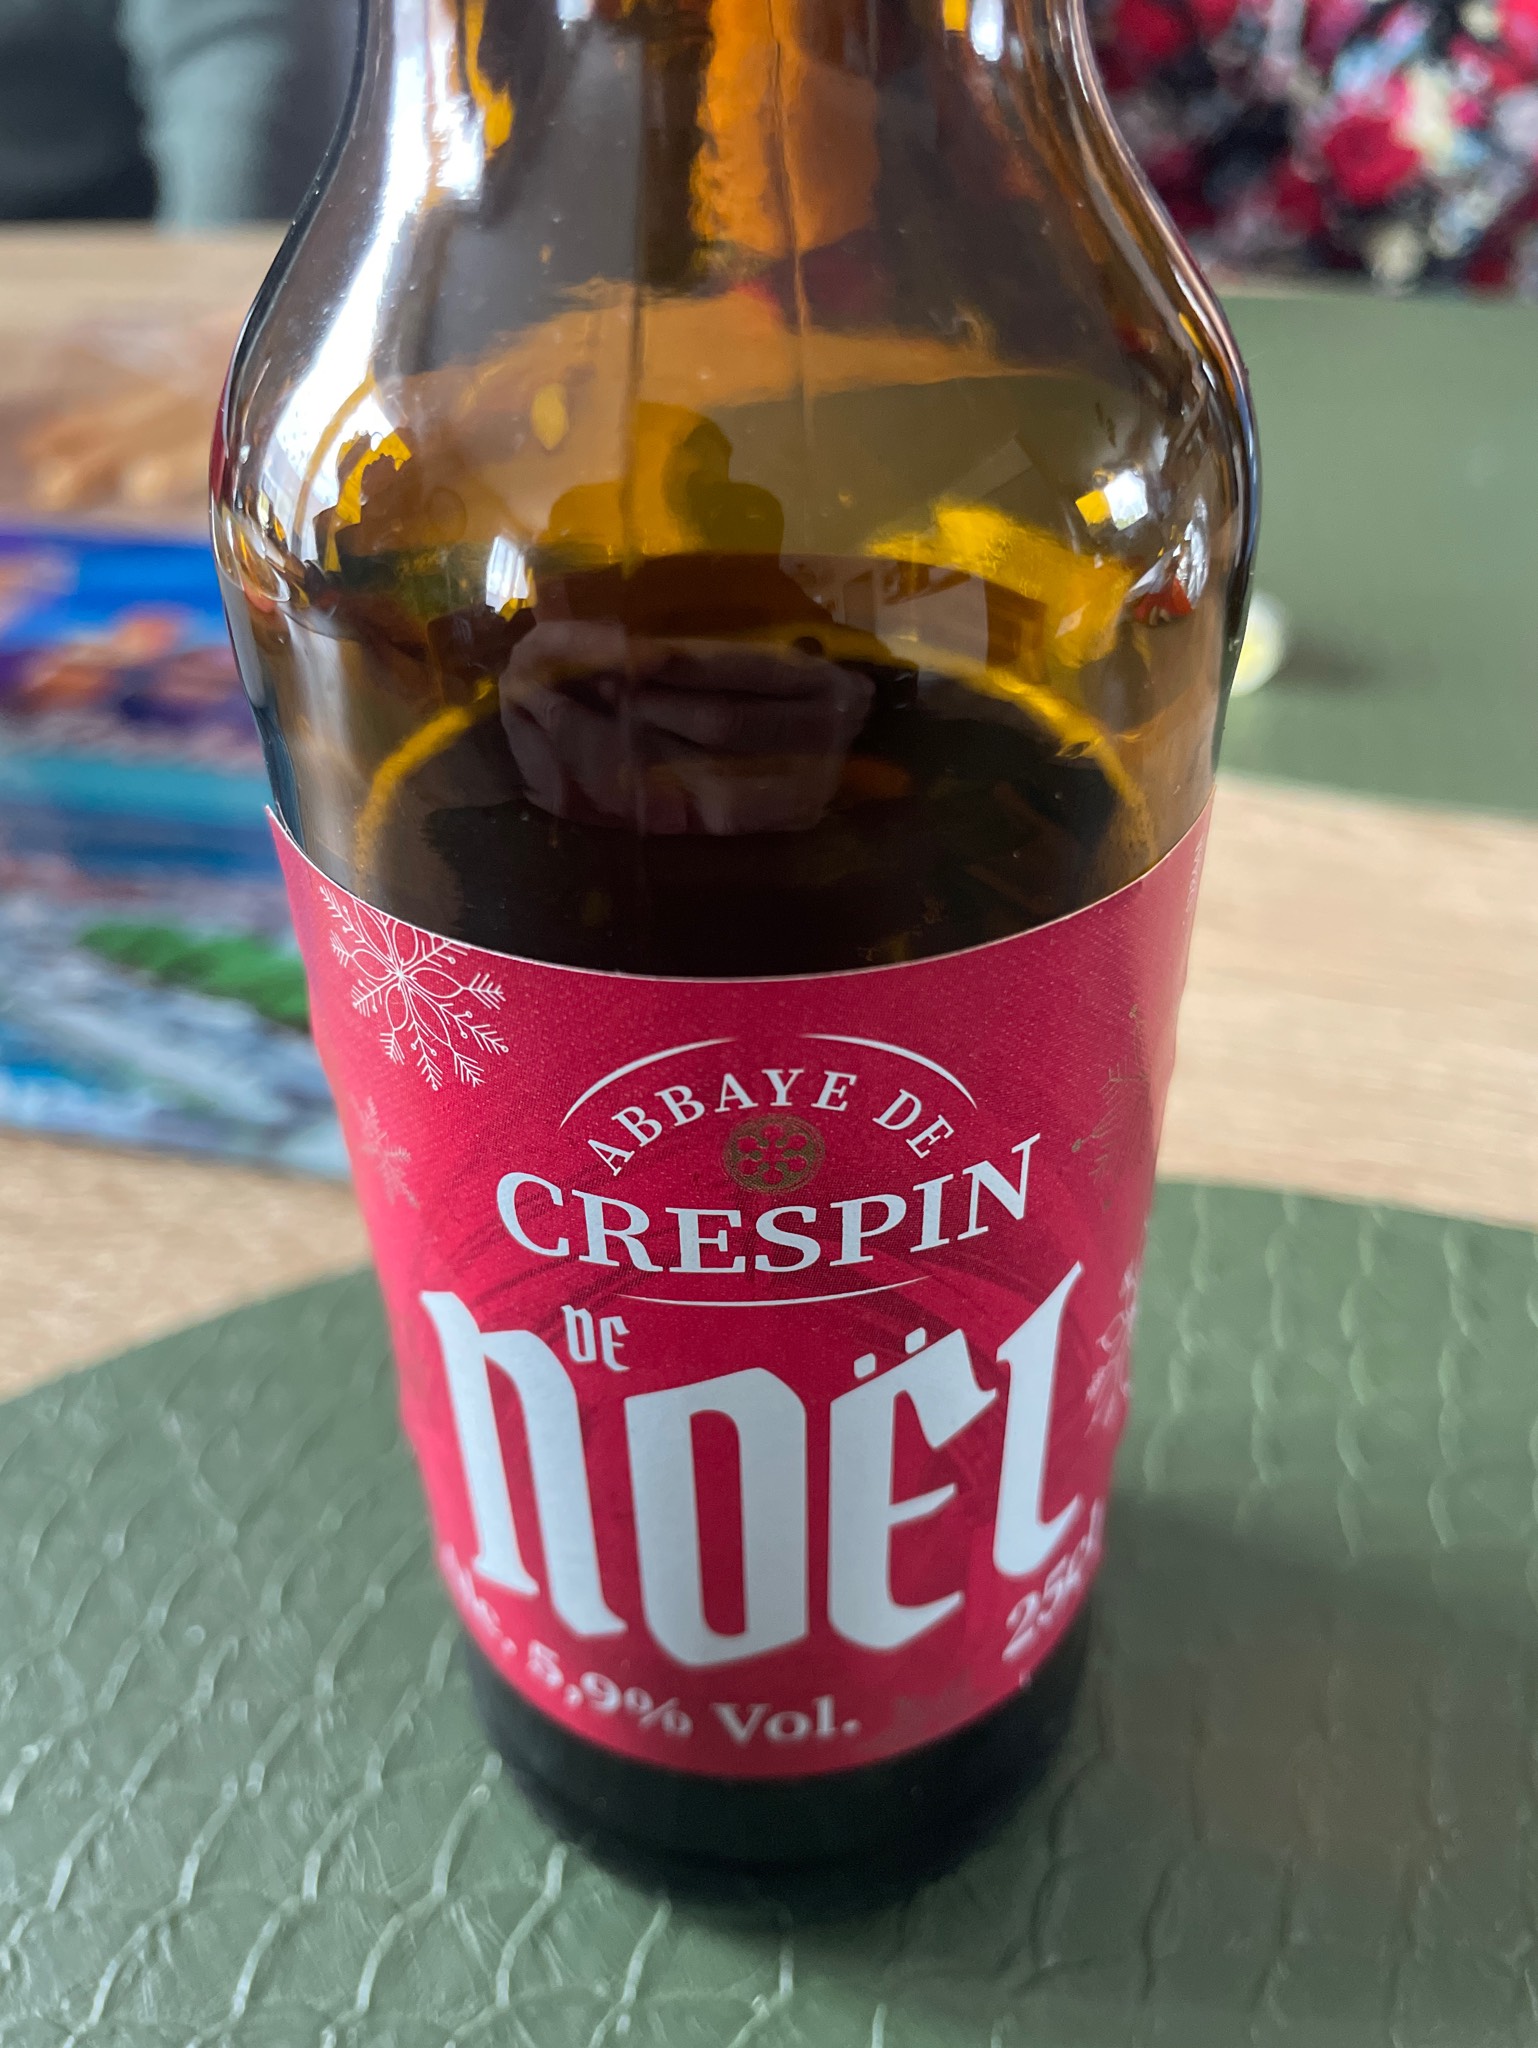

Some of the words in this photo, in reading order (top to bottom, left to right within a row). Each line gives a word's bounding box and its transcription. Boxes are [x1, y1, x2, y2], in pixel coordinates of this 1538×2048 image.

[587, 1068, 857, 1176] ABBAYE
[873, 1089, 955, 1160] DE
[496, 1132, 1042, 1274] CRESPIN
[561, 1304, 631, 1372] DE
[527, 1639, 694, 1738] 5,9%
[713, 1695, 862, 1748] Vol.
